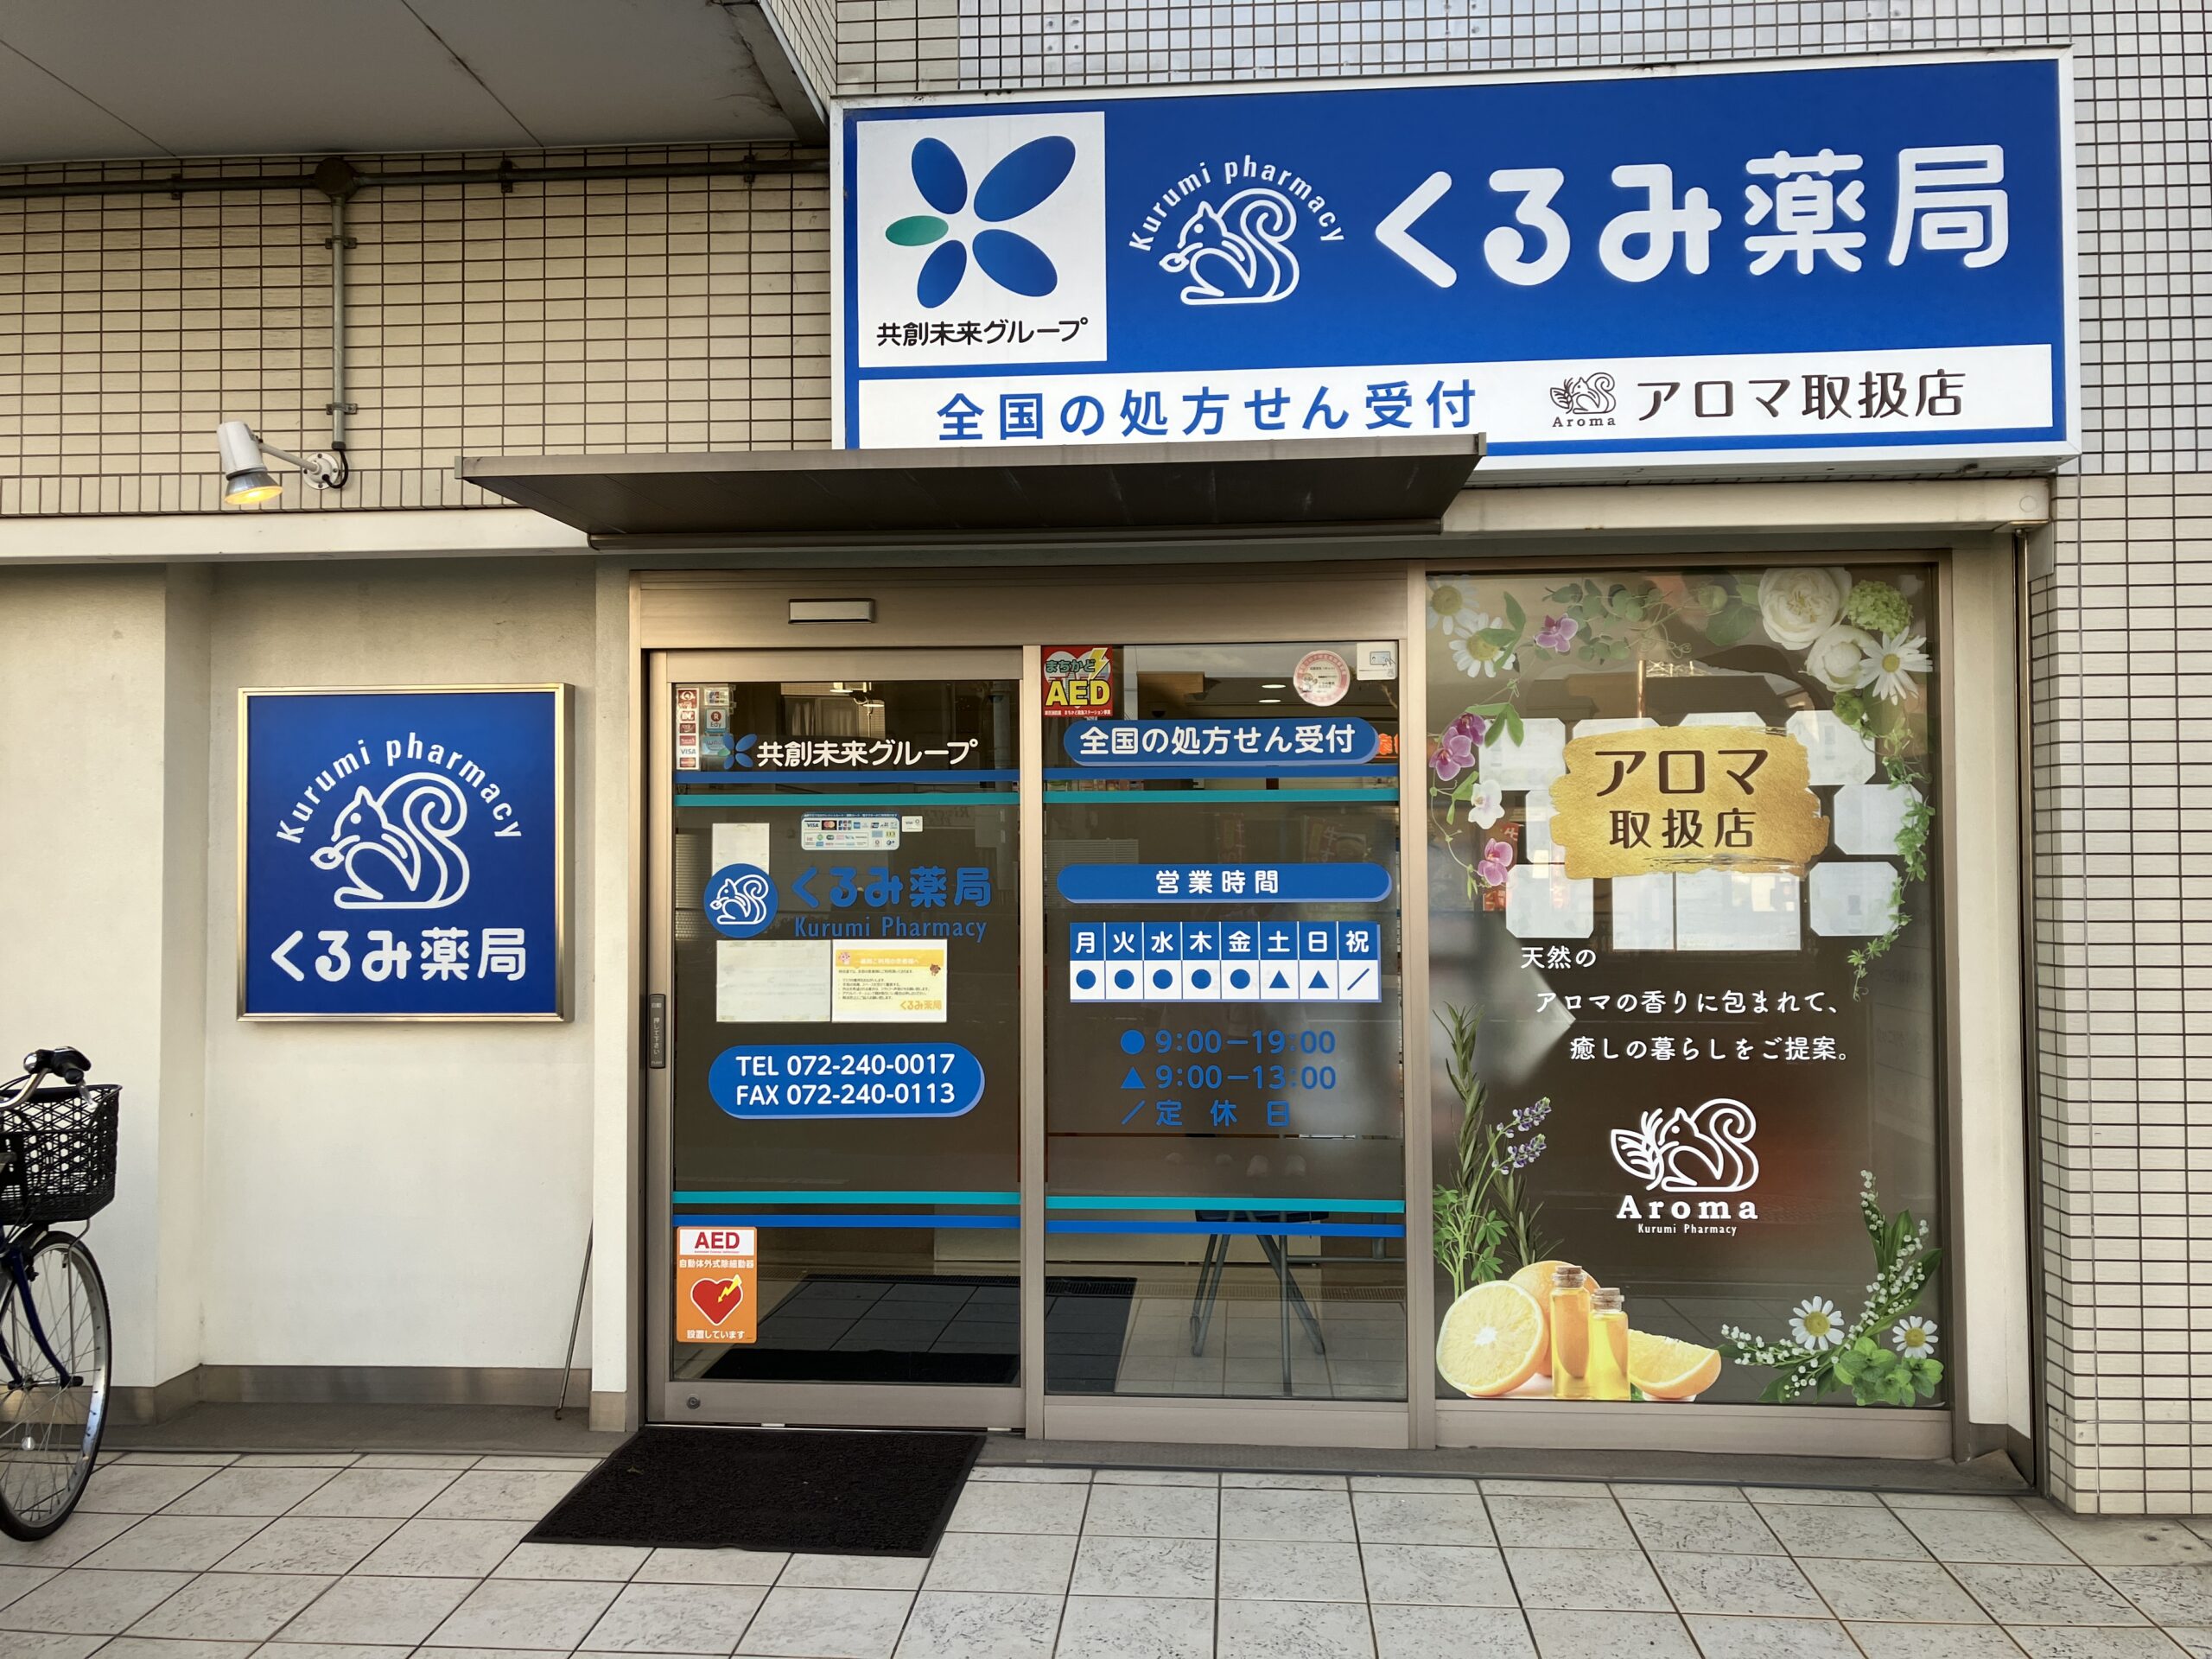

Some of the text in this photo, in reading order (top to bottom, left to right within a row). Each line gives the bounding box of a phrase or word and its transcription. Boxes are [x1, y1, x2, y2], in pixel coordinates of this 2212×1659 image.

[1129, 155, 1345, 251] Kurumi pharmacy
[1374, 144, 2009, 289] くるみ薬局
[876, 315, 1089, 347] 共創未来グループ
[1637, 369, 1967, 421] アロマ取扱店
[937, 379, 1476, 442] 全国の処方せん受付
[1552, 415, 1617, 428] Aroma
[1045, 659, 1096, 673] まちかど
[1045, 679, 1111, 706] AED
[756, 737, 979, 768] 共創未来グループ
[1079, 723, 1356, 756] 全国の処方せん受付
[1594, 749, 1769, 797] アロマ
[276, 731, 523, 845] Kurumi pharmacy
[1609, 808, 1757, 849] 取扱店
[791, 867, 991, 908] くるみ薬局
[1155, 869, 1280, 894] 営業時間
[794, 917, 988, 942] Kurumi Pharmacy
[1075, 931, 1370, 954] 月 火 水 木 金 土 日 祝
[270, 925, 526, 982] くるみ薬局
[1521, 945, 1597, 969] 天然の
[1535, 989, 1840, 1015] アロマの香りに包まれて、
[1569, 1036, 1850, 1062] 癒しの暮らしをご提案。
[735, 1053, 956, 1077] TEL 072-240-0017
[735, 1083, 956, 1107] FAX 072-240-0113
[1616, 1194, 1758, 1222] Aroma
[695, 1231, 740, 1249] AED
[1637, 1223, 1738, 1237] Kurumi Pharmacy
[679, 1259, 754, 1268] 自動体外式除細動器
[687, 1330, 745, 1339] 設置しています
